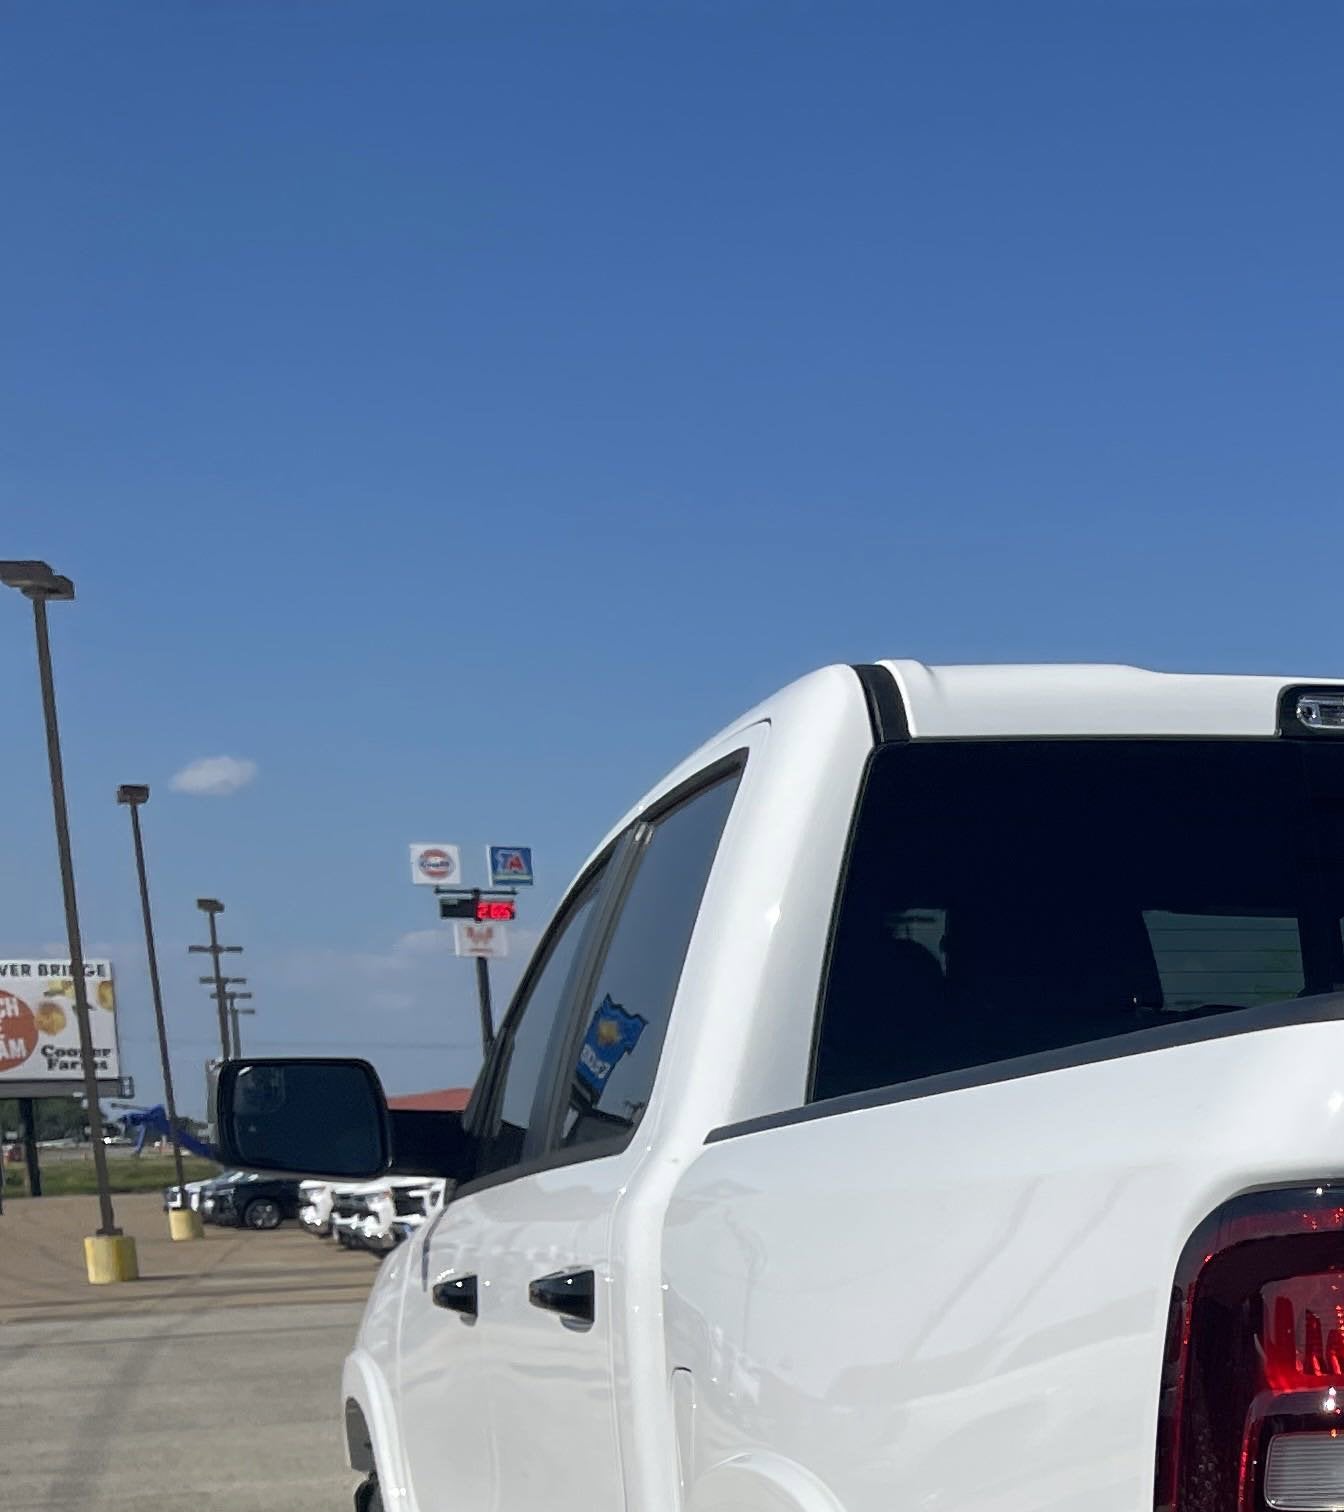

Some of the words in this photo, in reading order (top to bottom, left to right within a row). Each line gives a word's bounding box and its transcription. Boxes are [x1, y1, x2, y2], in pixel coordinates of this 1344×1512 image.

[38, 964, 106, 978] BRIGE
[41, 1045, 111, 1057] Cooer
[47, 1057, 108, 1072] Fars
